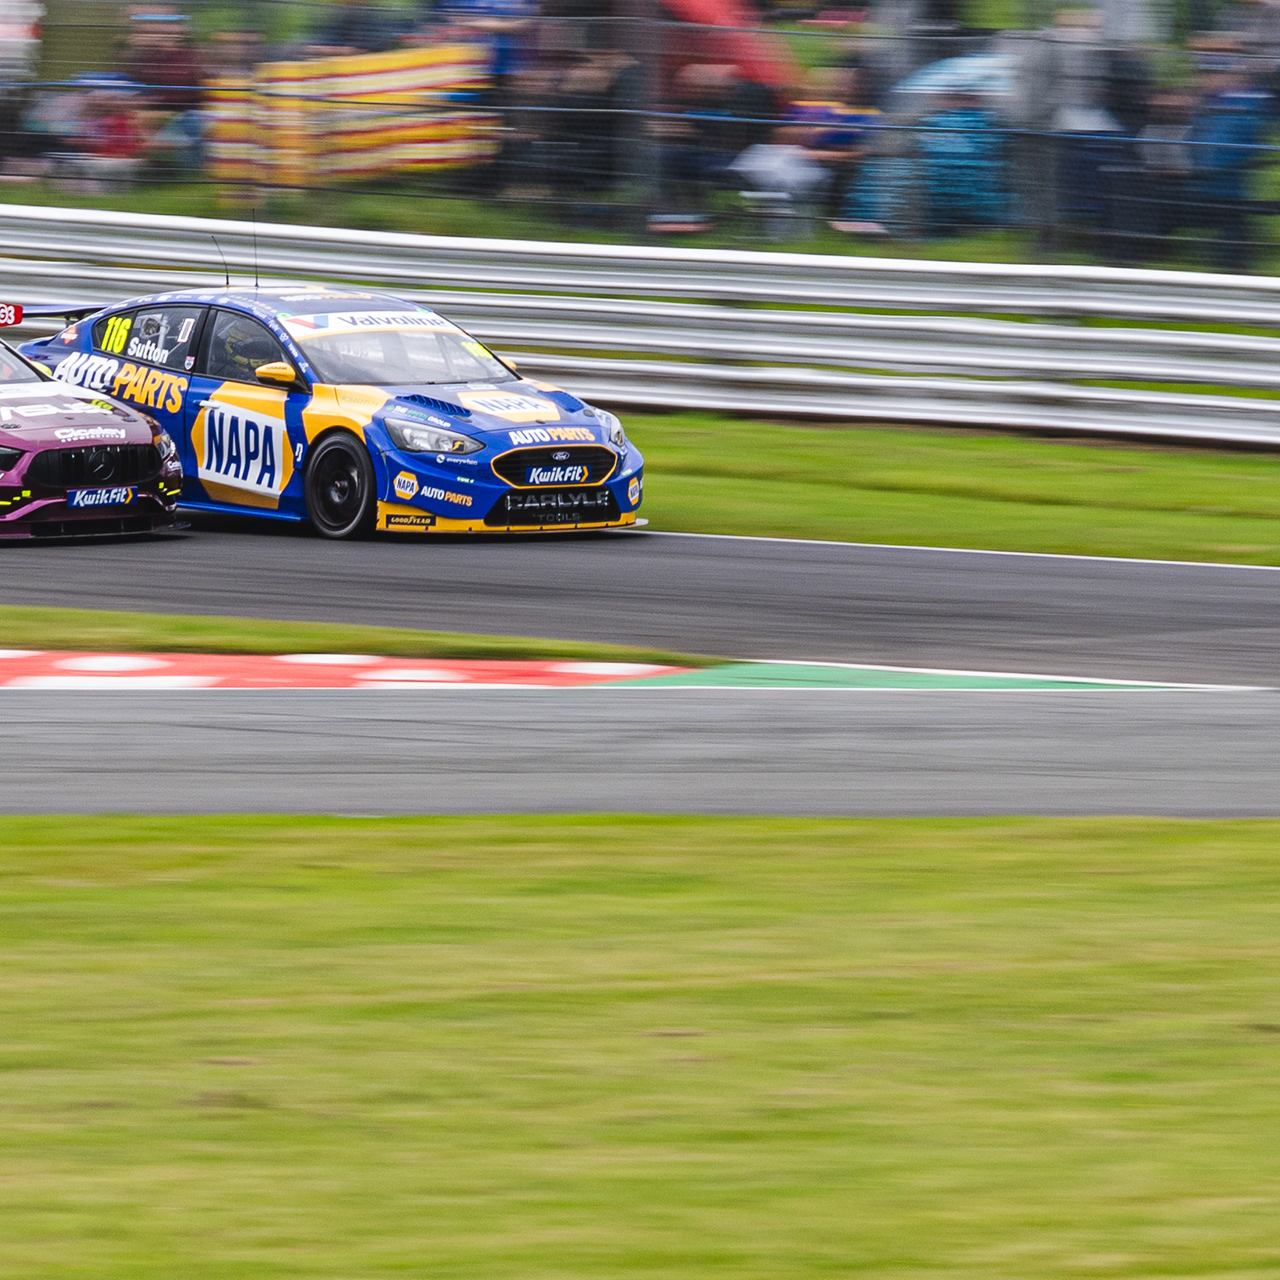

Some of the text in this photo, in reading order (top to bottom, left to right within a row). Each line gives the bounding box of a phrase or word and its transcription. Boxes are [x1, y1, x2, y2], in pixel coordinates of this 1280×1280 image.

[338, 315, 446, 327] Valvoline
[101, 316, 131, 353] 116
[127, 337, 170, 363] Sutton
[52, 351, 189, 414] AUTO PARTS
[472, 397, 545, 412] NAPA
[54, 426, 126, 439] Ciceley
[509, 427, 595, 445] AUTO PARTS
[206, 409, 276, 489] NAPA
[529, 465, 582, 484] KwikFit
[397, 477, 415, 493] NAPA
[73, 488, 127, 507] KwikFit
[420, 485, 473, 507] AUTO PARTS
[505, 491, 609, 510] CARLYLE
[391, 516, 431, 524] GOODYEAR
[535, 512, 581, 522] TOOLS
